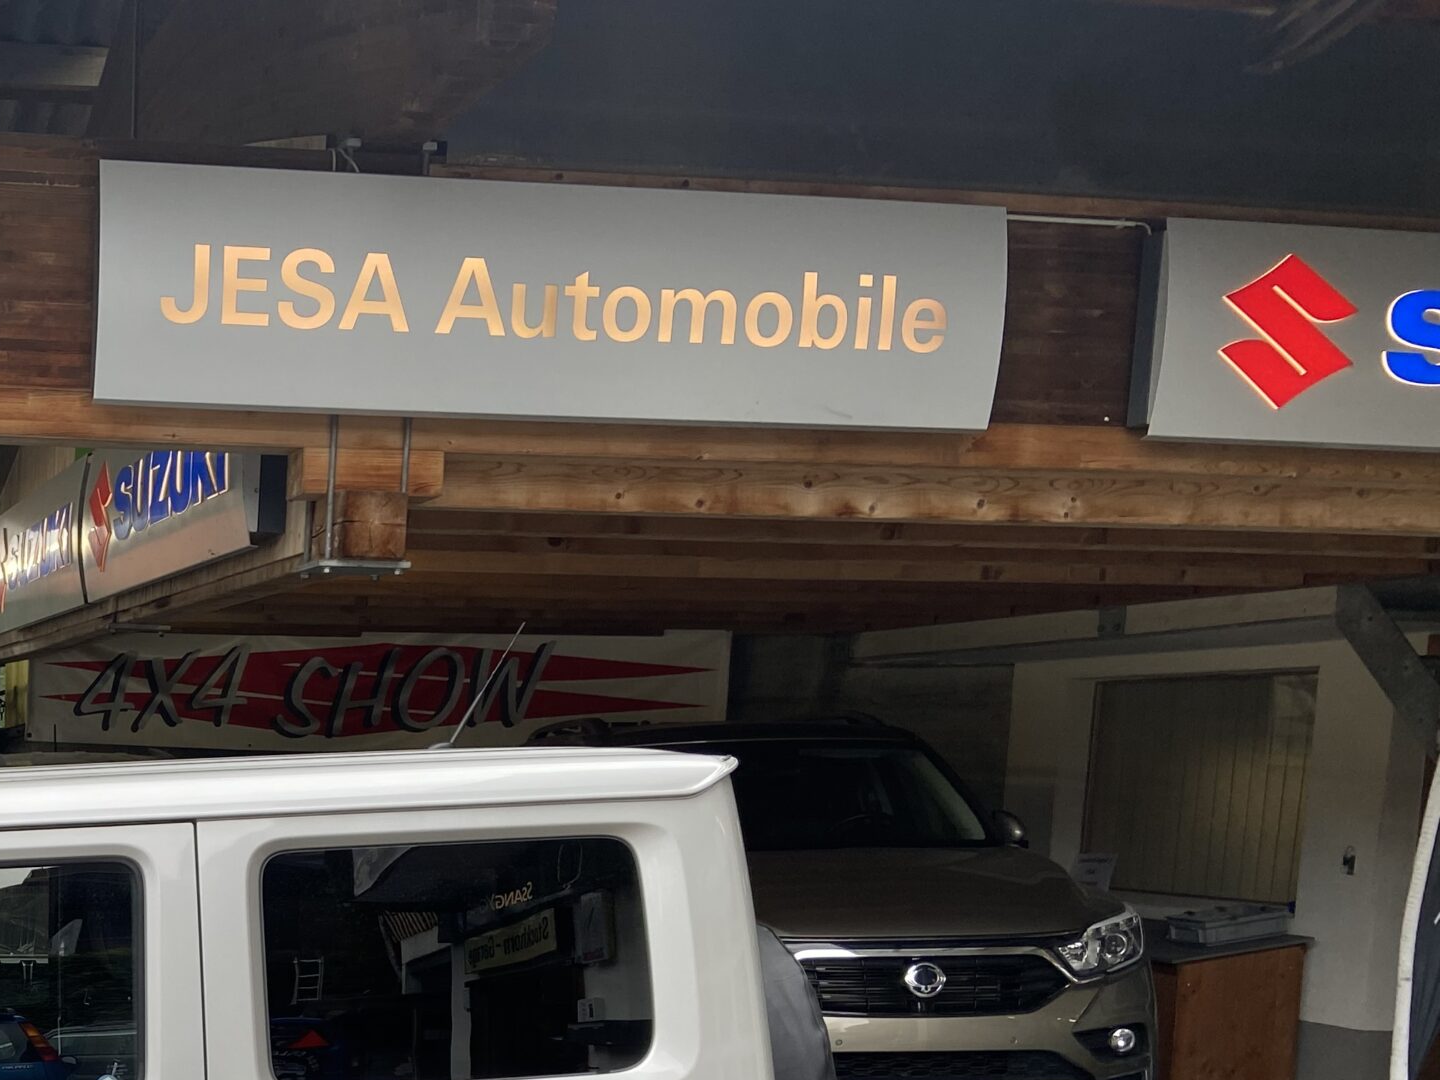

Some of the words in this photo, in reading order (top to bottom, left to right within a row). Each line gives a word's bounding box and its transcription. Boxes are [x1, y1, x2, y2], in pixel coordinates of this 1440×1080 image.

[159, 242, 410, 335] JESA
[434, 255, 948, 355] Automobile
[112, 450, 229, 541] SUZUKI
[7, 501, 74, 591] SUZUKI
[272, 640, 557, 739] SHOW
